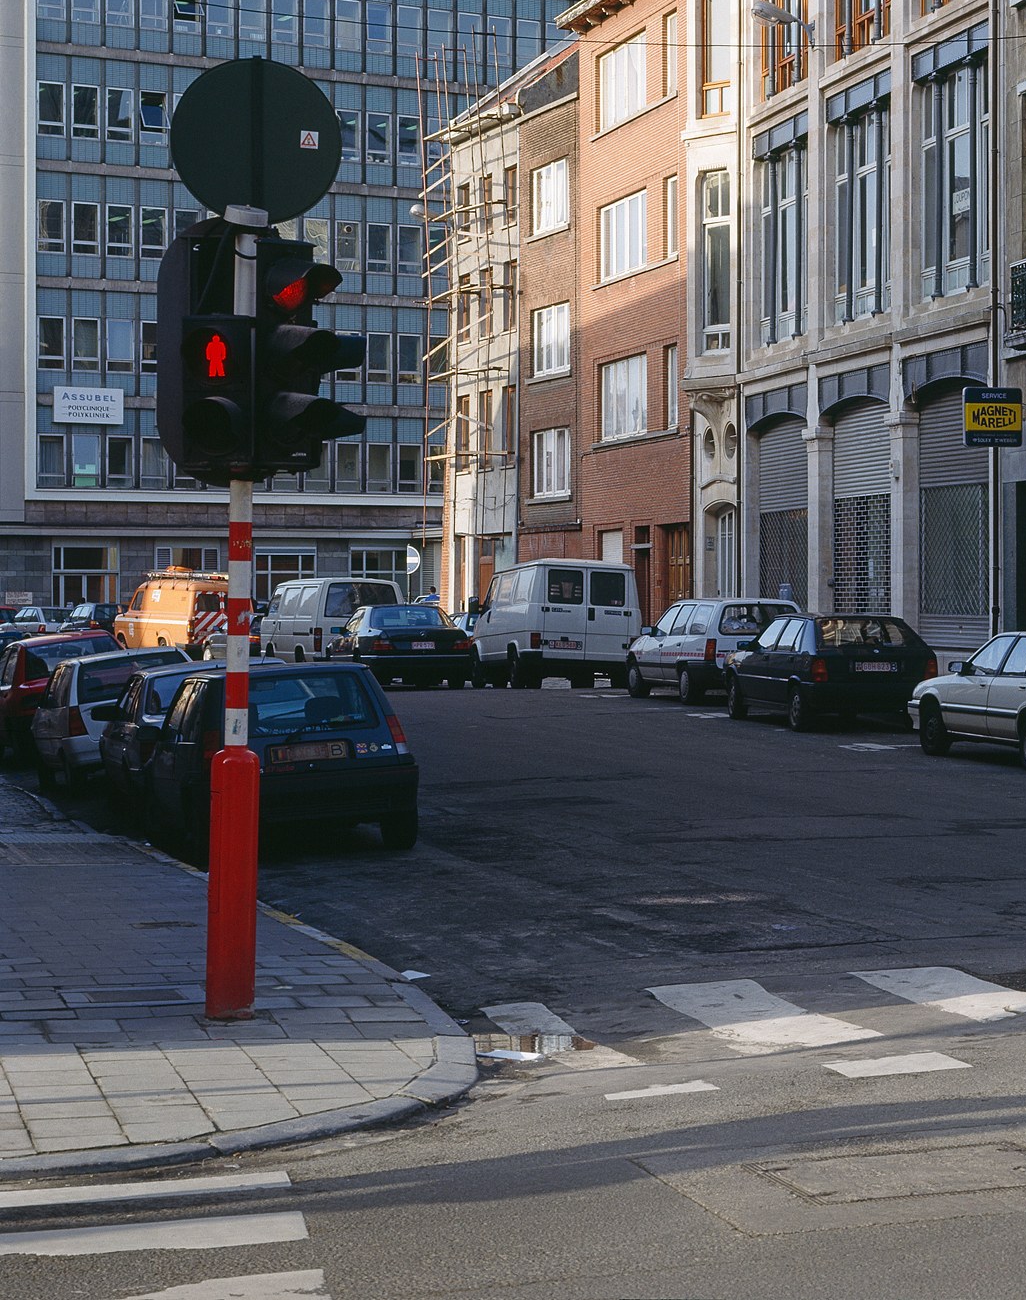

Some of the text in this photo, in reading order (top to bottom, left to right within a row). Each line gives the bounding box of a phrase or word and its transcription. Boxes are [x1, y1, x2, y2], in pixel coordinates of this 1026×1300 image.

[62, 392, 116, 402] ASSUBEL
[972, 405, 1016, 421] MAGNETI
[972, 414, 1016, 428] MARELLI
